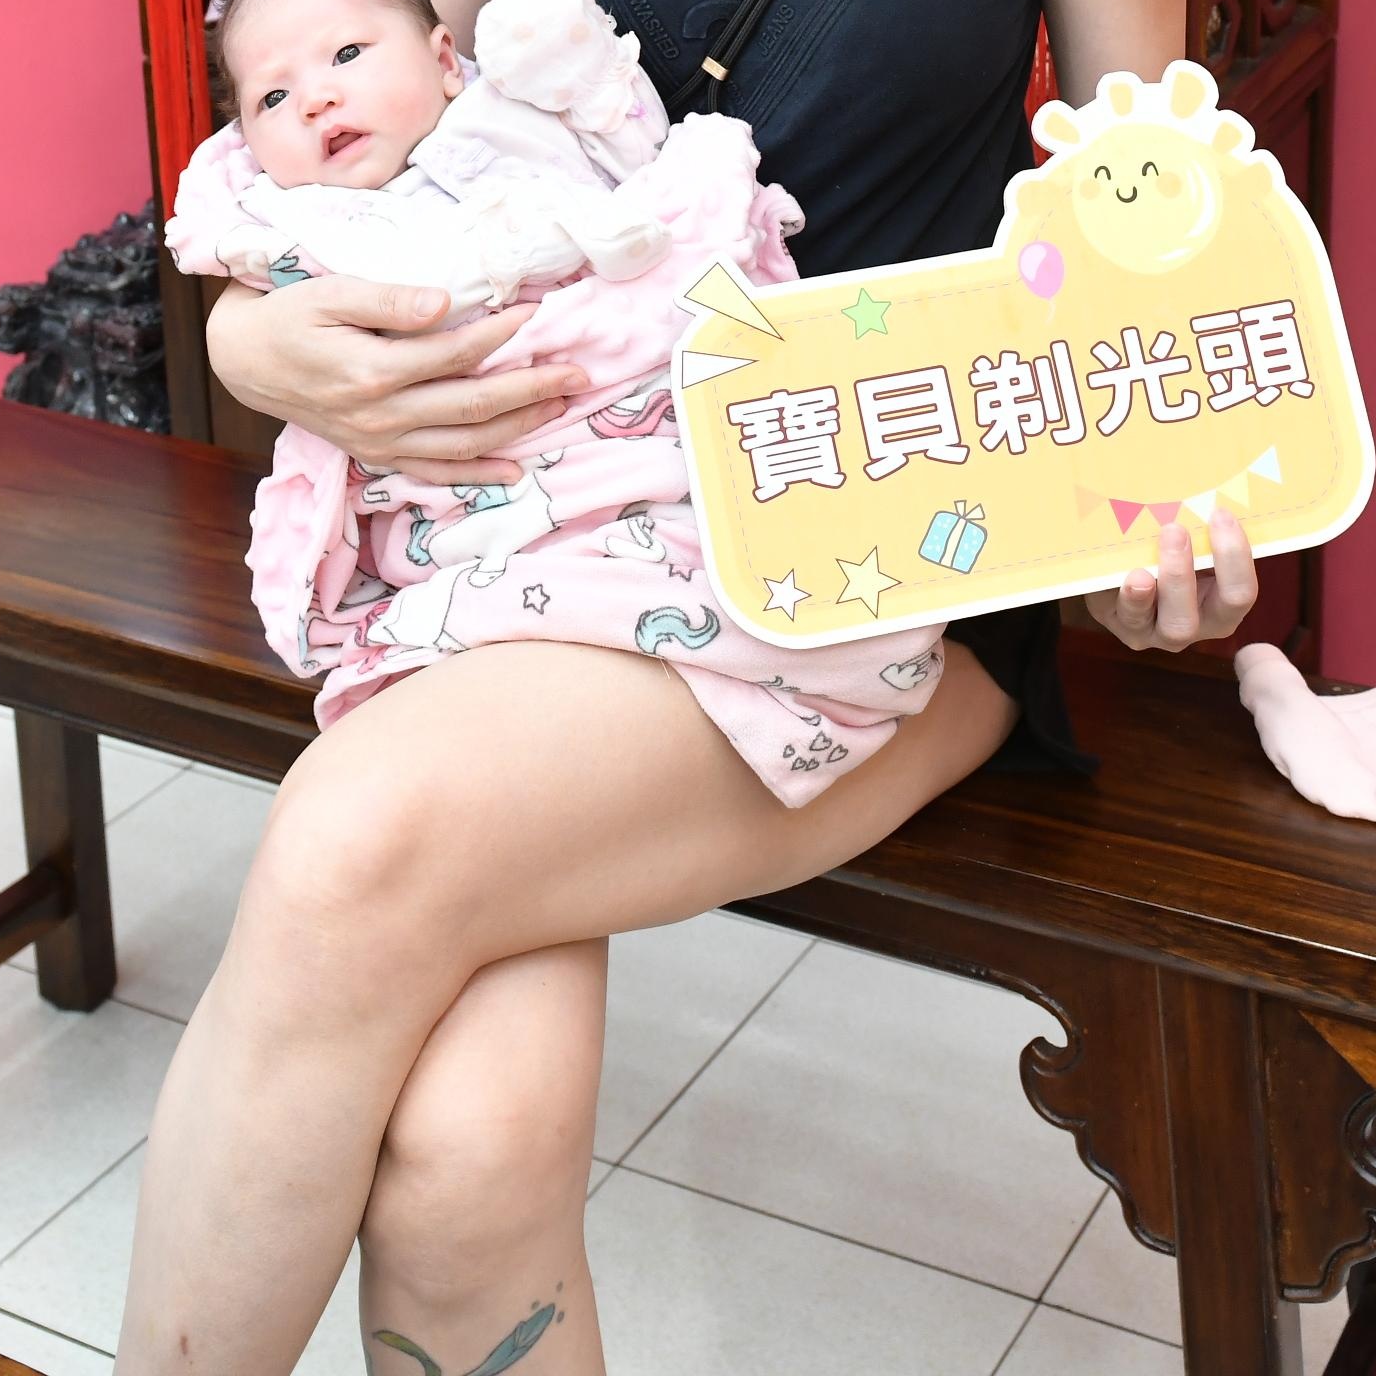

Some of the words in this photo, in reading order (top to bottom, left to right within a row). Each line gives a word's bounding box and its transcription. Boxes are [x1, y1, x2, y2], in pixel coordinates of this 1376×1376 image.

[758, 4, 795, 57] JEANS
[727, 300, 1314, 502] 寶貝剃光頭
